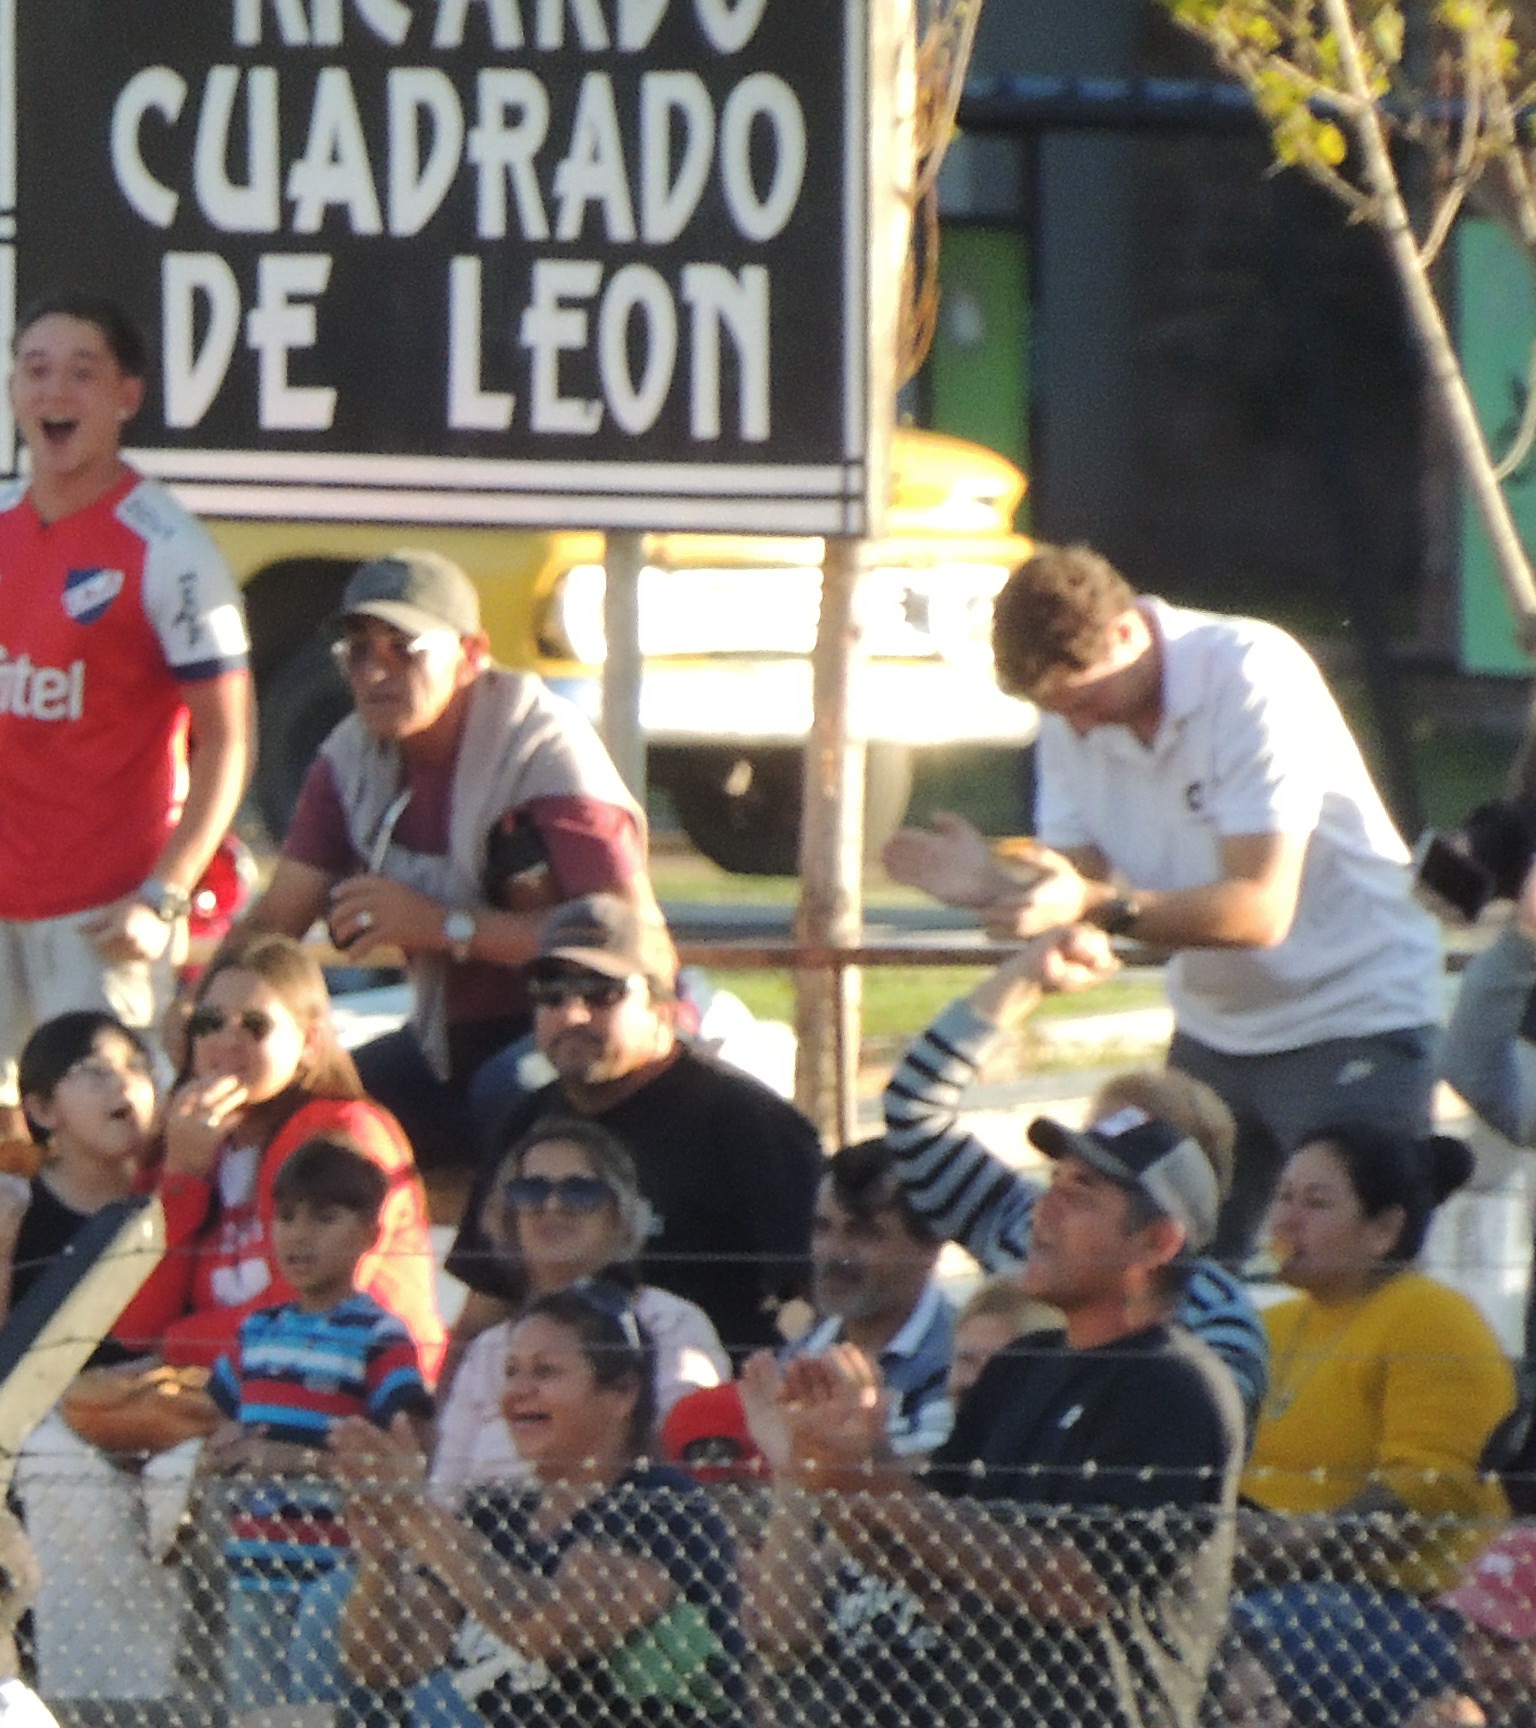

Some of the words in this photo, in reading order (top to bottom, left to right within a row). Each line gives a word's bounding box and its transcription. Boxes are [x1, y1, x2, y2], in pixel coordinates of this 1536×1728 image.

[109, 64, 808, 245] CUADRADO
[159, 251, 339, 431] DE
[446, 253, 772, 443] LEON
